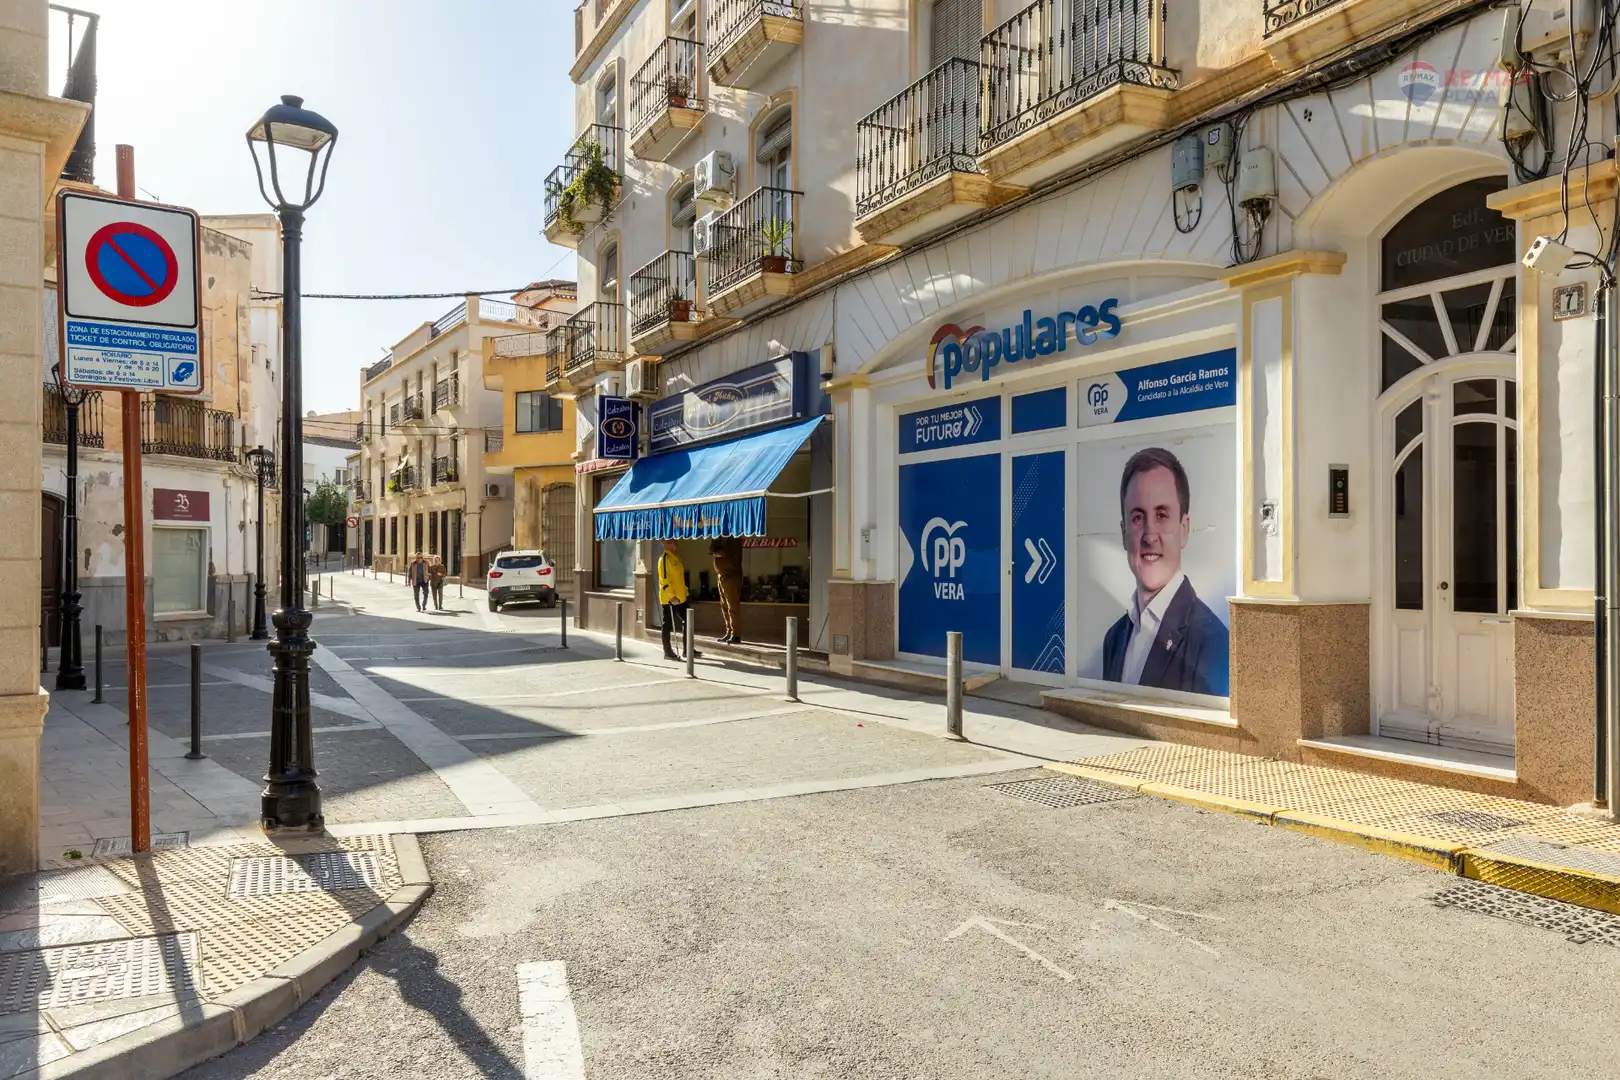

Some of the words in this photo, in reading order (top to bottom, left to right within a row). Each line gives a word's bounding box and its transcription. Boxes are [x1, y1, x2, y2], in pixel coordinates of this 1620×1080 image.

[1397, 240, 1452, 266] CIUDAD
[1458, 234, 1479, 254] DE
[1565, 293, 1573, 310] 7
[69, 325, 88, 333] ZONA
[102, 328, 160, 340] ESTACIONAMIENTO
[162, 333, 195, 343] REGULADO
[70, 334, 97, 342] TICKET
[112, 338, 147, 346] CONTROL
[149, 341, 194, 350] OBLIGATORIO
[944, 298, 1122, 390] populares
[1138, 378, 1168, 391] Alfonso
[1170, 371, 1196, 385] García
[1199, 367, 1229, 380] Ramos
[1138, 391, 1166, 402] Candidato
[1205, 383, 1213, 391] de
[1214, 380, 1229, 388] Vera
[916, 416, 929, 428] POR
[930, 414, 940, 424] TU
[940, 410, 962, 423] MEJOR
[1094, 408, 1108, 416] VERA
[916, 422, 962, 444] FUTURO
[742, 537, 798, 548] REBAJAS
[934, 582, 965, 600] VERA
